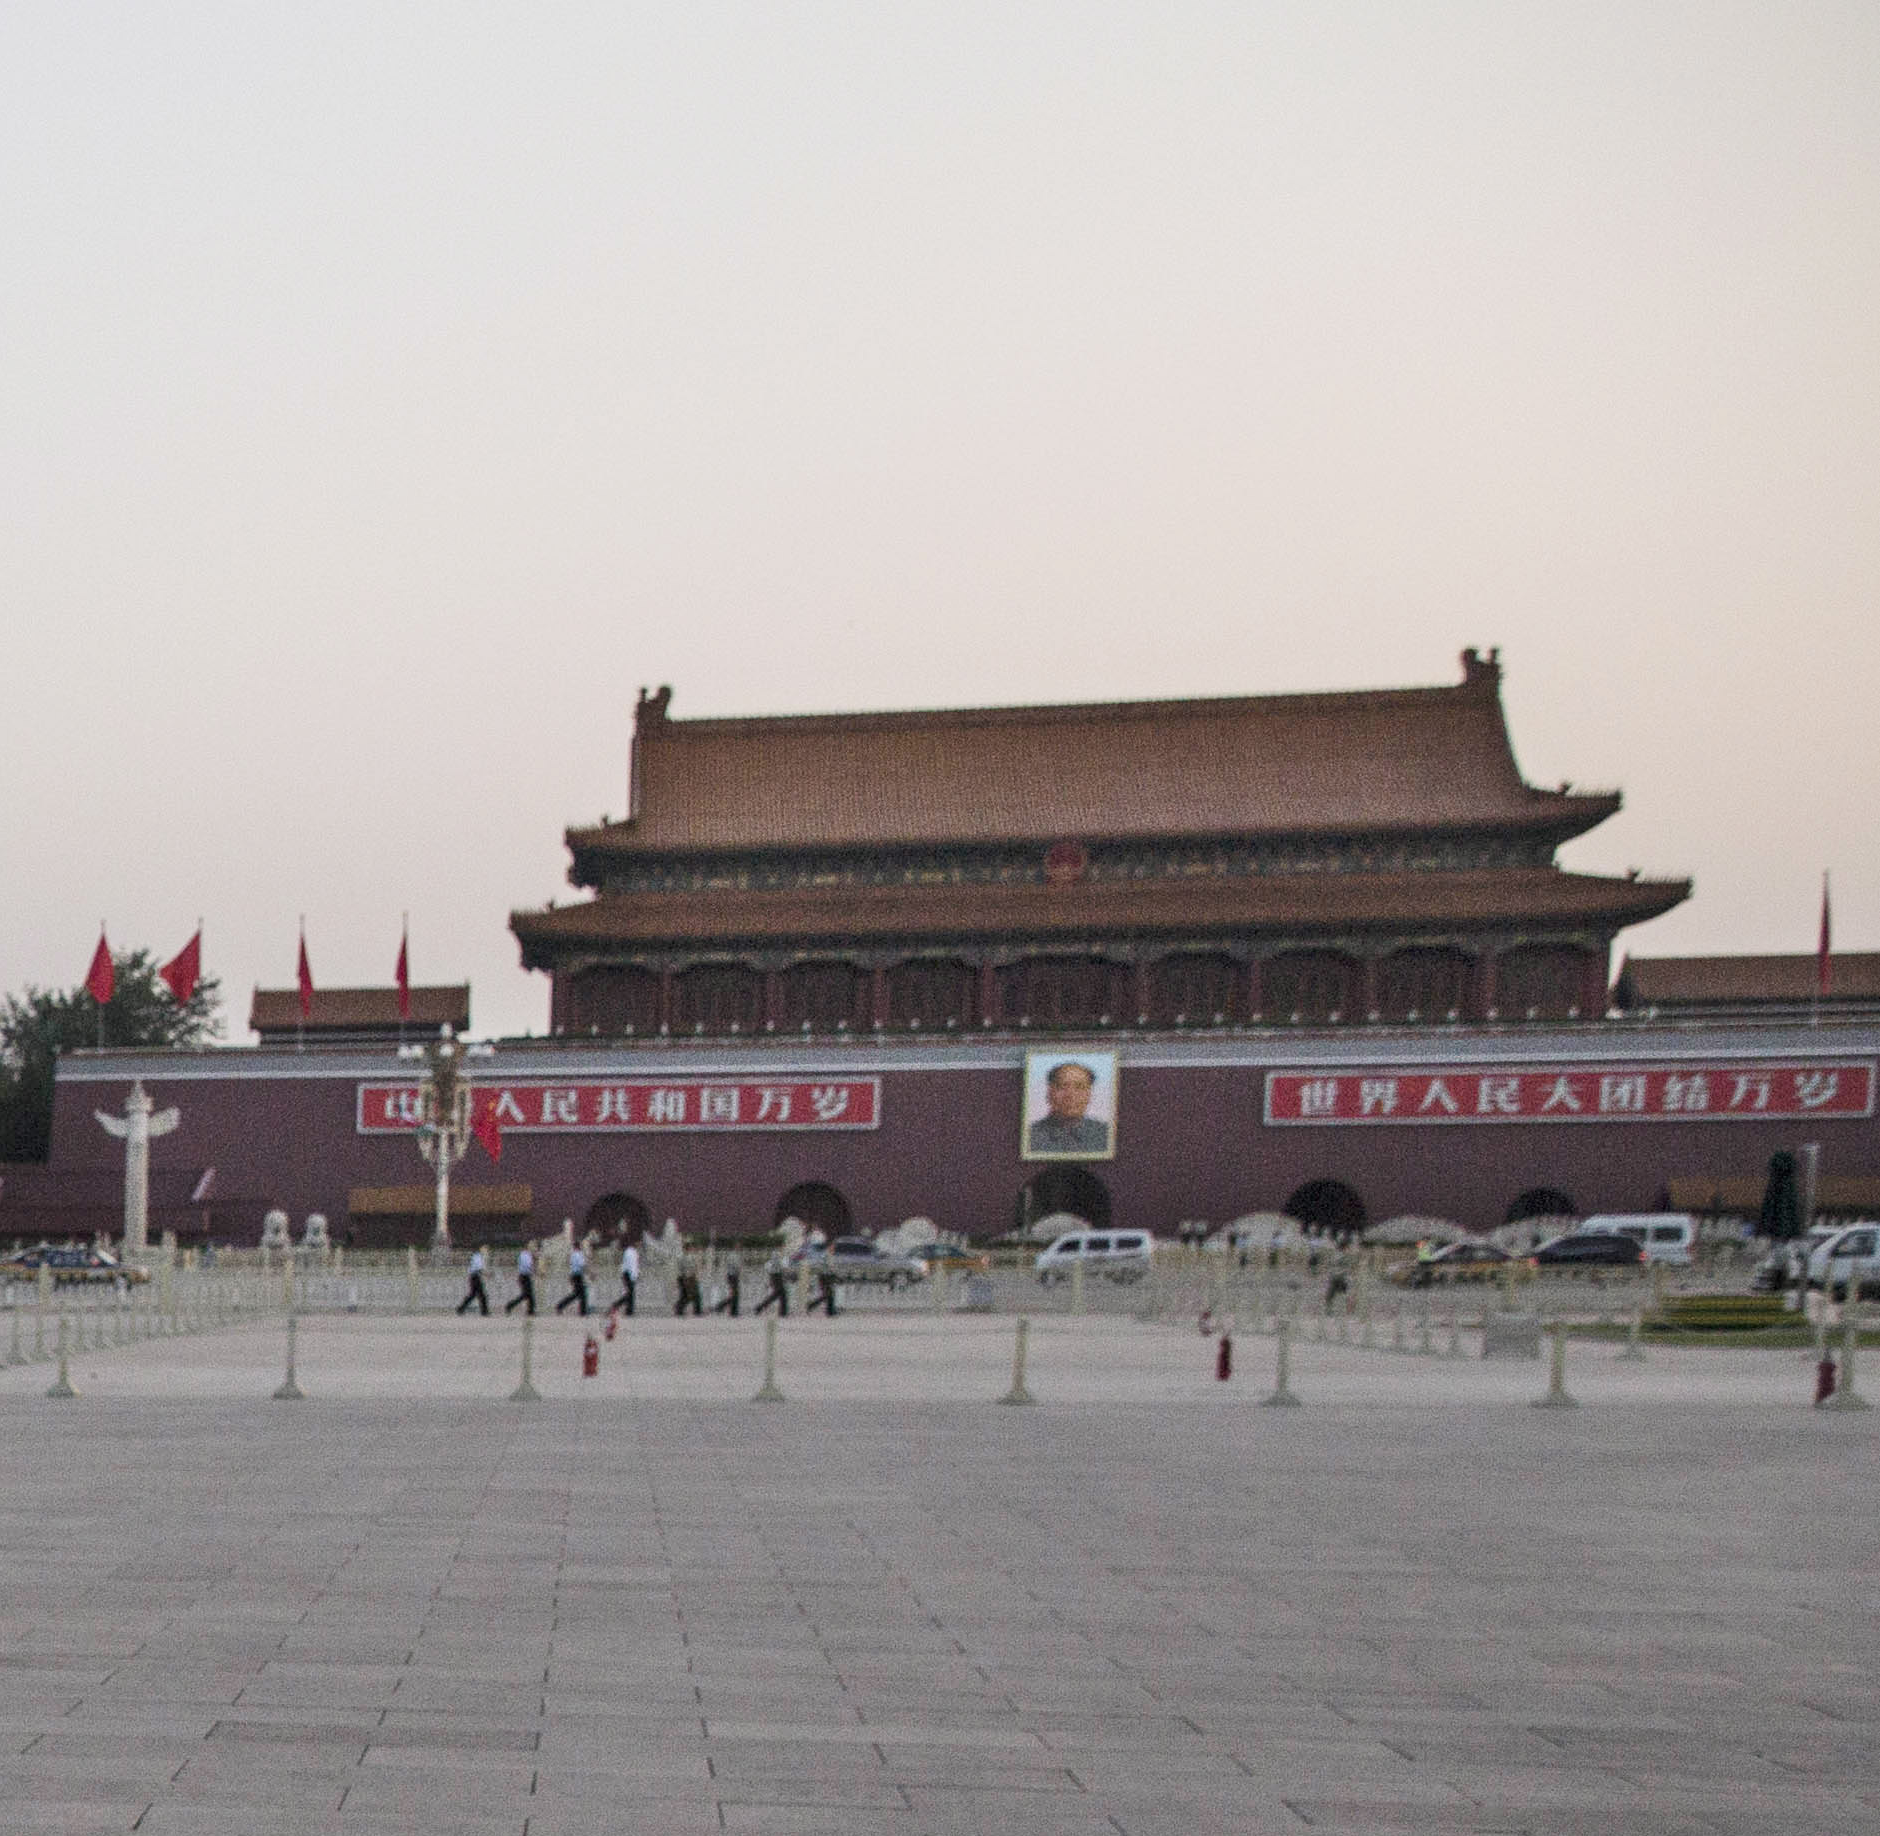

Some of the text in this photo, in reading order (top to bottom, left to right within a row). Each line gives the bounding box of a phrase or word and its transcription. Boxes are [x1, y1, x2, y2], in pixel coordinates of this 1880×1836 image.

[384, 1087, 849, 1122] 中人民共和国万岁
[1299, 1073, 1837, 1116] 世界人民大团结万岁
